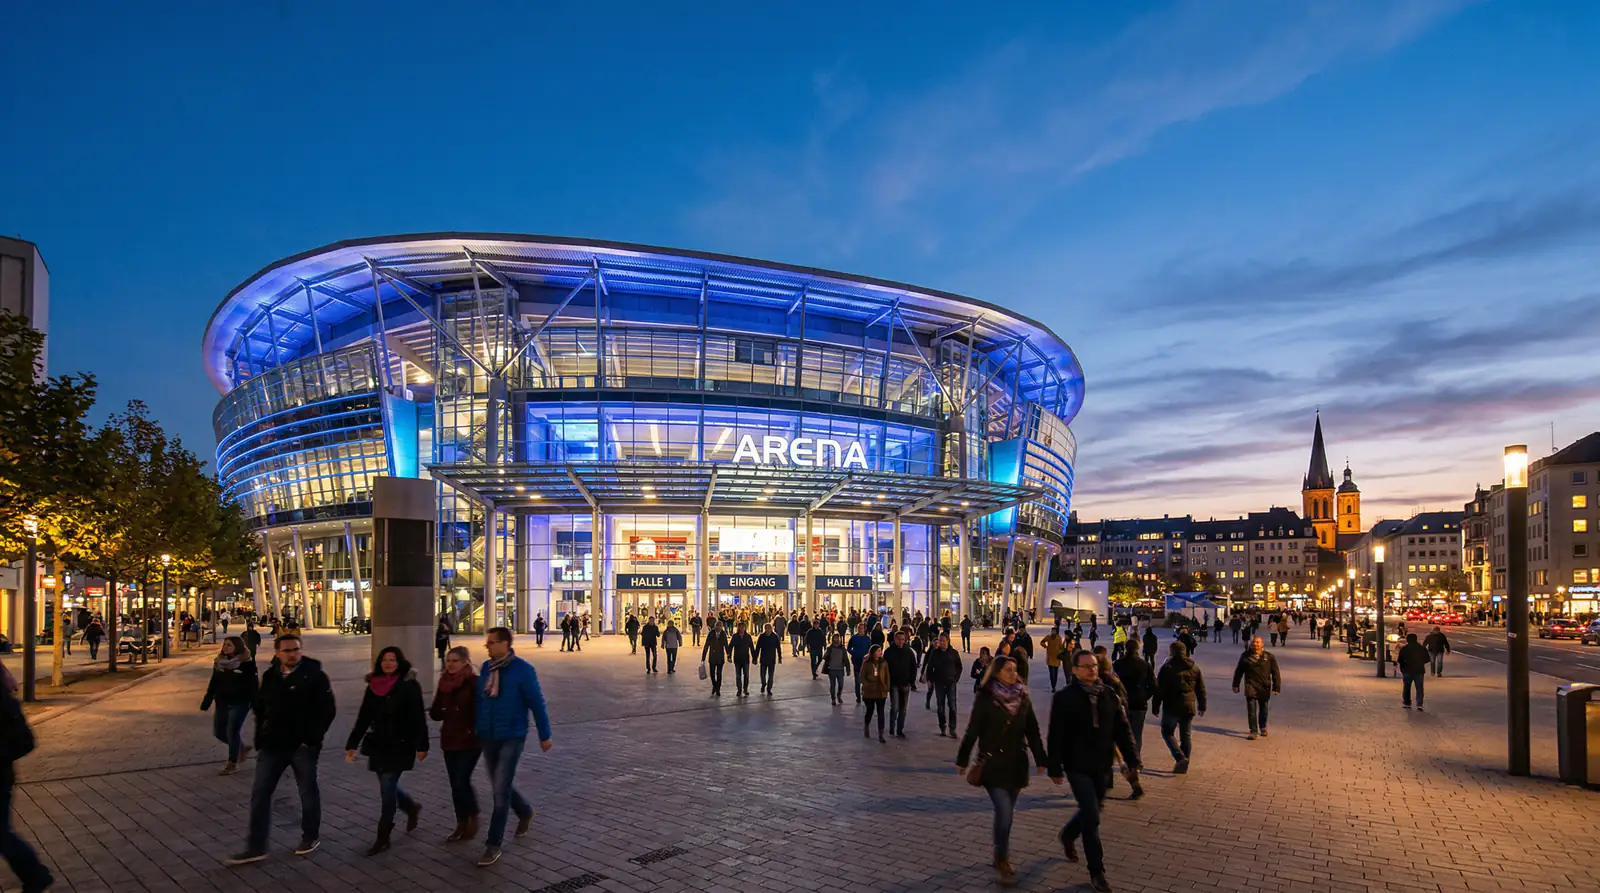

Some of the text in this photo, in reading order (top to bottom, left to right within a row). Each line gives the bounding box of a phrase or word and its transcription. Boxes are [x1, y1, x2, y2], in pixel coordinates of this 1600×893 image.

[732, 434, 868, 469] ARENA
[631, 577, 672, 587] HALLE 1
[729, 577, 776, 587] EINGANG
[827, 578, 861, 588] HALLE 1
